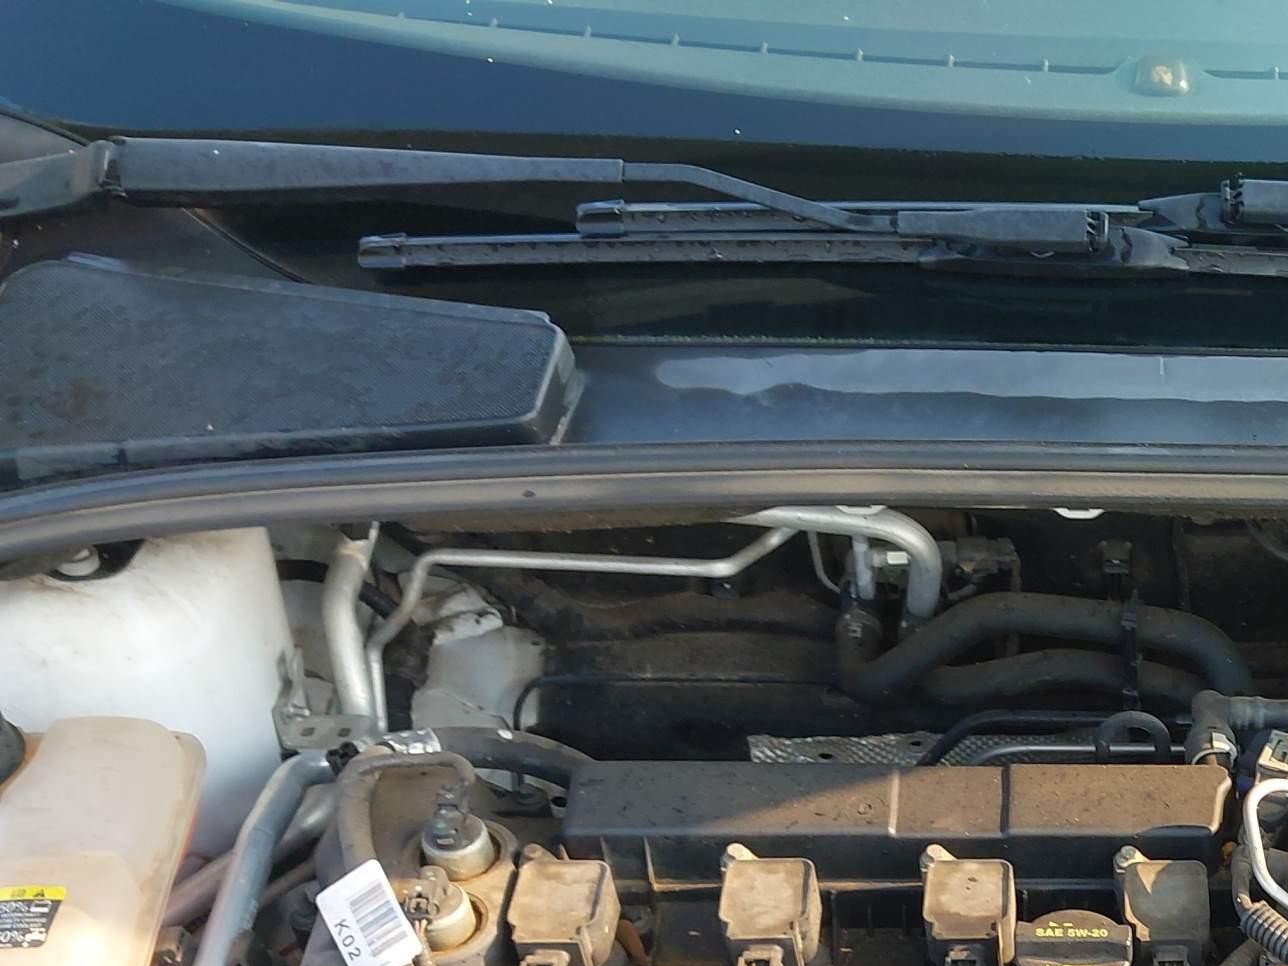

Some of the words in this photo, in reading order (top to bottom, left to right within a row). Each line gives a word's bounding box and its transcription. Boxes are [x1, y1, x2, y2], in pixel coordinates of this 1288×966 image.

[334, 919, 362, 961] K02
[1035, 927, 1064, 937] SAE
[1067, 928, 1109, 937] 5W-20
